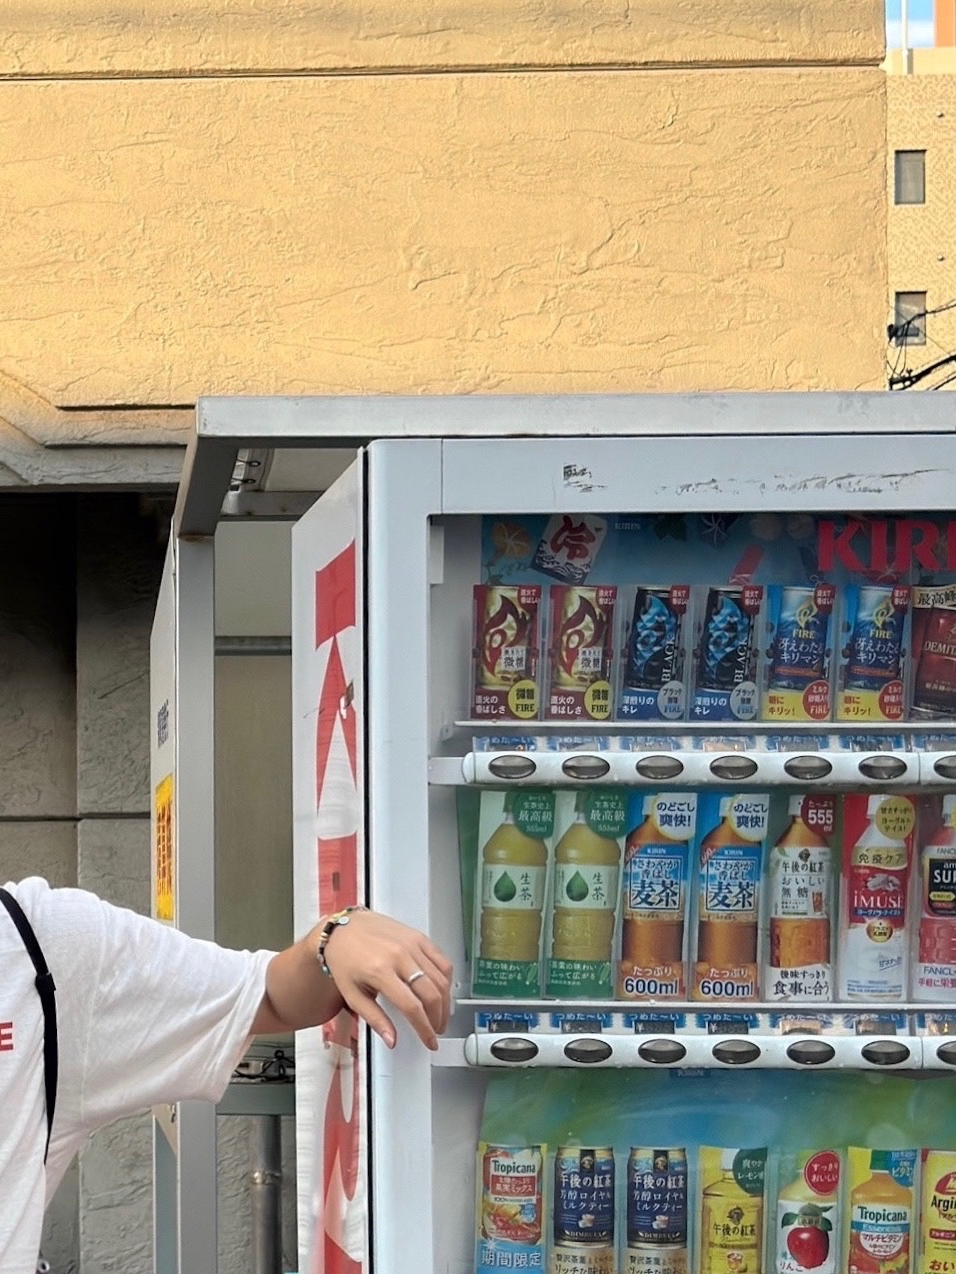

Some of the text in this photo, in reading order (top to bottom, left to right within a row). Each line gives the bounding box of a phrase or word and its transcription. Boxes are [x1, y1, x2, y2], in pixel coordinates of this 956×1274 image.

[615, 522, 641, 531] KIRIN
[793, 628, 815, 639] FIRE
[870, 629, 892, 639] FIRE
[661, 636, 675, 681] BLACK
[734, 638, 747, 682] BLACK
[780, 652, 820, 664] キリマン
[856, 652, 896, 664] キリマン
[515, 703, 535, 713] FIRE
[591, 704, 609, 713] FIRE
[622, 706, 638, 714] キレ
[694, 706, 711, 715] キレ
[810, 705, 828, 714] FIRE
[886, 705, 902, 714] FIRE
[657, 802, 695, 812] のどごし
[734, 803, 768, 813] のどごし
[519, 810, 553, 822] 最高級
[591, 809, 624, 822] 最高級
[659, 815, 691, 827] 爽快!
[808, 809, 833, 824] 555
[736, 816, 764, 828] 爽快!
[859, 854, 903, 864] 免疫ケア
[782, 861, 825, 873] 午後の紅茶
[520, 872, 532, 900] 生茶
[591, 872, 605, 900] 生茶
[782, 876, 825, 886] おいしい
[632, 880, 678, 907] 麦茶
[709, 881, 755, 908] 麦茶
[781, 887, 809, 899] 無糖
[633, 966, 672, 977] たっぷり
[709, 968, 748, 978] たっぷり
[780, 970, 826, 979] 後味すっきり
[625, 978, 678, 995] 600ml
[701, 980, 754, 996] 600ml
[773, 981, 830, 996] 食事に合う
[492, 1160, 536, 1174] Tropicana
[560, 1173, 611, 1188] 午後の紅茶
[634, 1174, 685, 1190] 午後の紅茶
[812, 1174, 839, 1182] おいしい
[857, 1206, 907, 1223] Tropicana
[713, 1223, 756, 1236] 午後の紅茶
[482, 1250, 541, 1267] 期間限定
